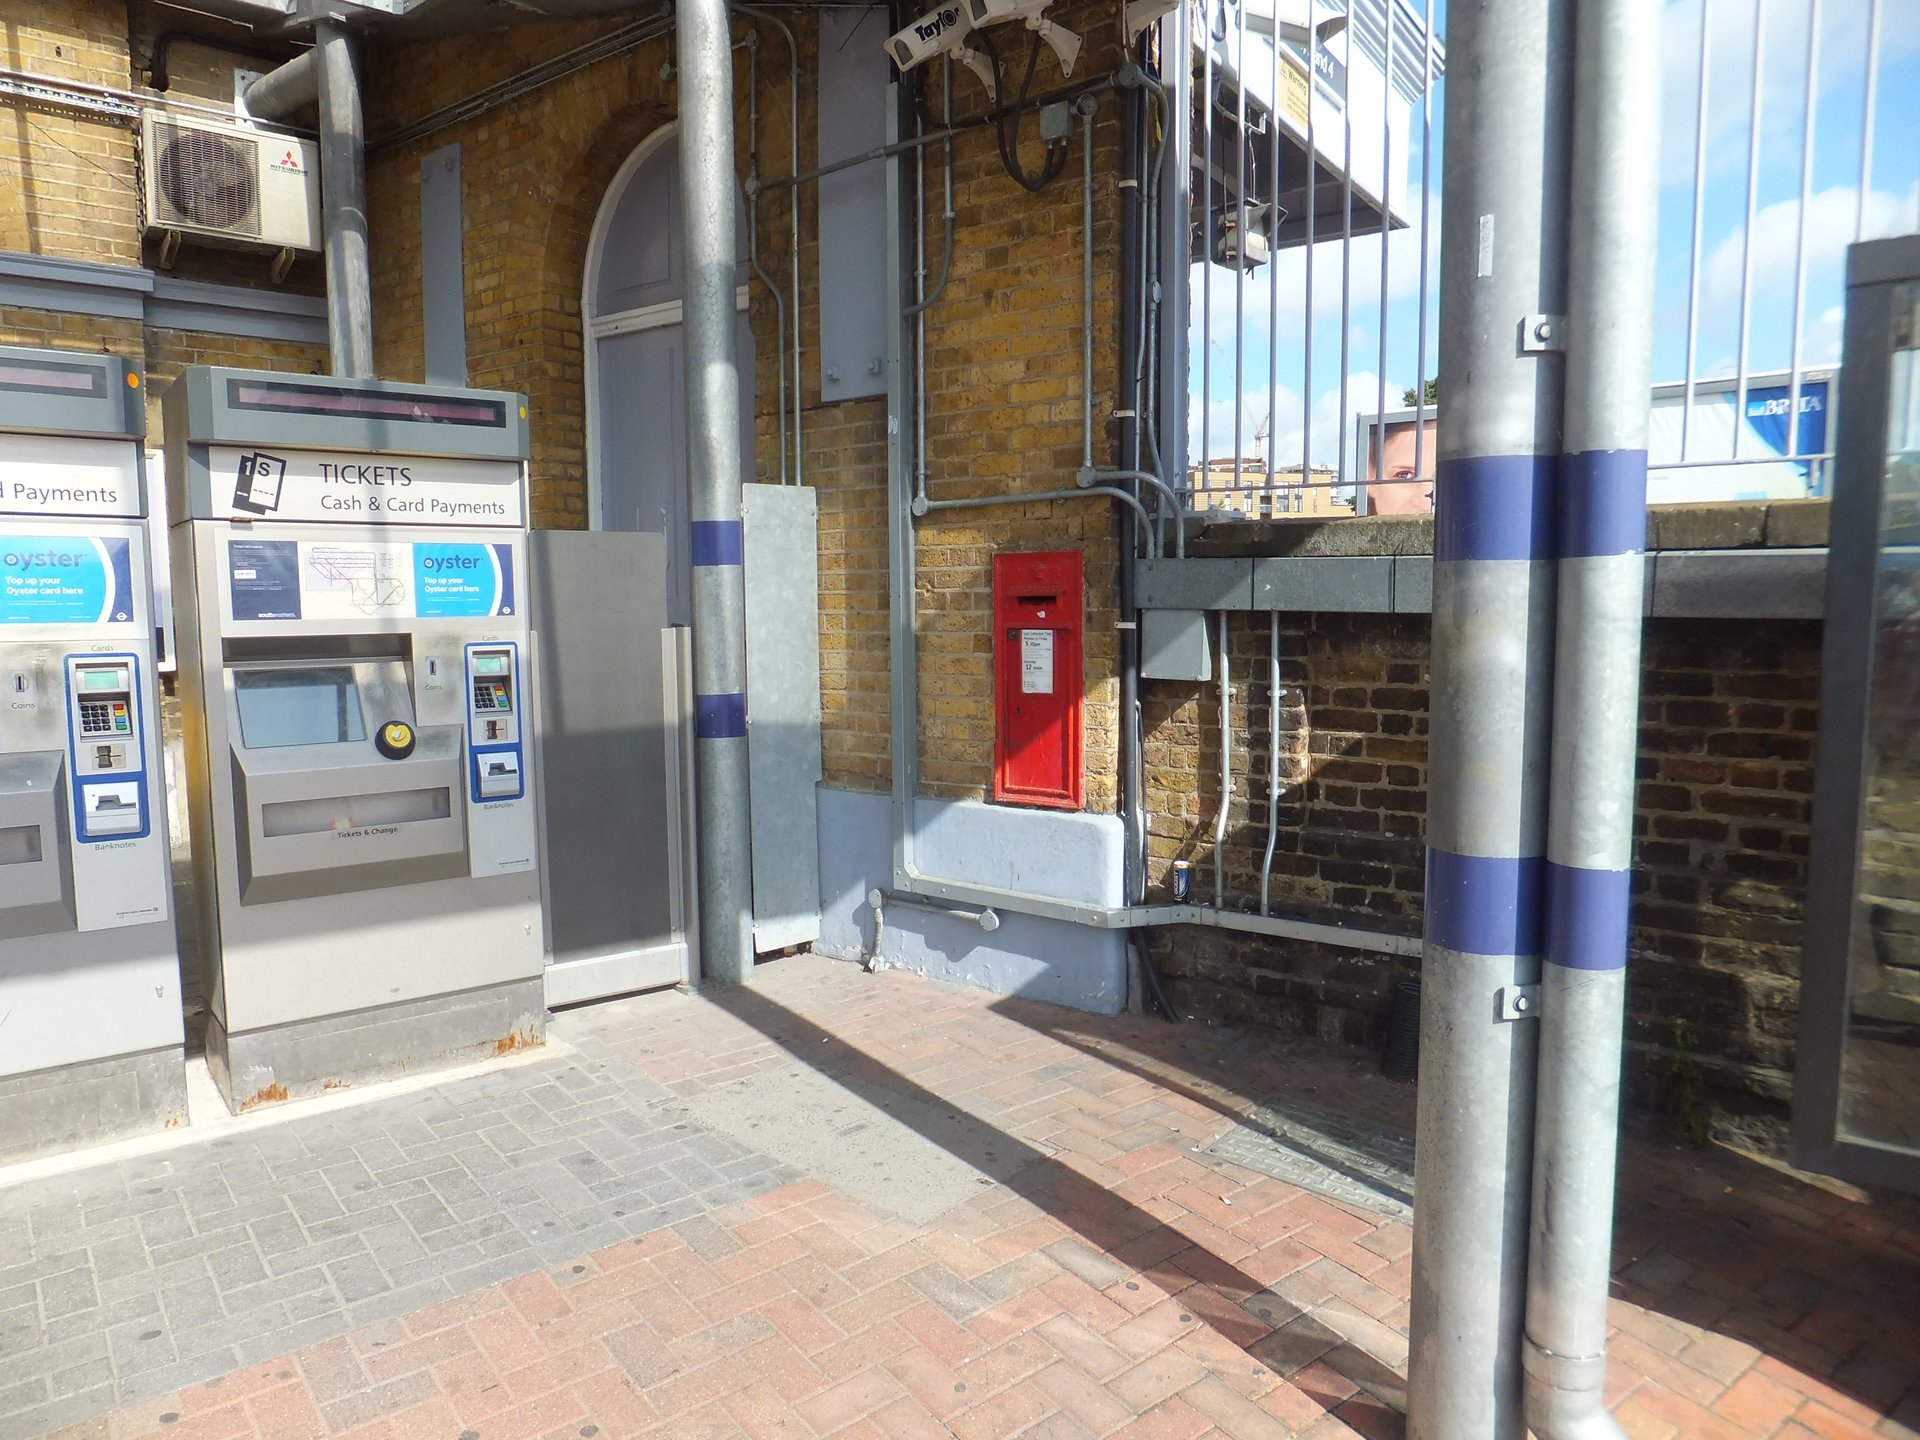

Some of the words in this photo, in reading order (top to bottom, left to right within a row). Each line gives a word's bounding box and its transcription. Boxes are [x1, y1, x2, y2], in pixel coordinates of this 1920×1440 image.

[914, 6, 959, 42] Taylor
[1327, 61, 1334, 80] 4
[257, 462, 270, 477] S
[319, 463, 412, 486] TICKETS
[13, 483, 118, 504] Payments
[321, 495, 362, 512] Cash
[368, 496, 381, 512] &
[386, 497, 425, 513] Card
[431, 499, 506, 518] Payments
[4, 550, 82, 571] oyster
[423, 554, 480, 573] oyster
[5, 575, 22, 586] Top
[25, 576, 37, 586] up
[39, 577, 61, 586] your
[424, 576, 437, 584] Top
[438, 577, 447, 585] up
[448, 577, 464, 585] your
[6, 586, 38, 596] Oyster
[40, 585, 61, 594] card
[62, 585, 83, 595] here
[424, 585, 447, 594] Oyster
[447, 584, 464, 593] card
[464, 584, 480, 593] here
[11, 702, 36, 710] Coins
[484, 802, 514, 810] Banknotes
[337, 831, 362, 839] Tickets
[371, 827, 398, 835] Change
[94, 841, 137, 851] Banknotes
